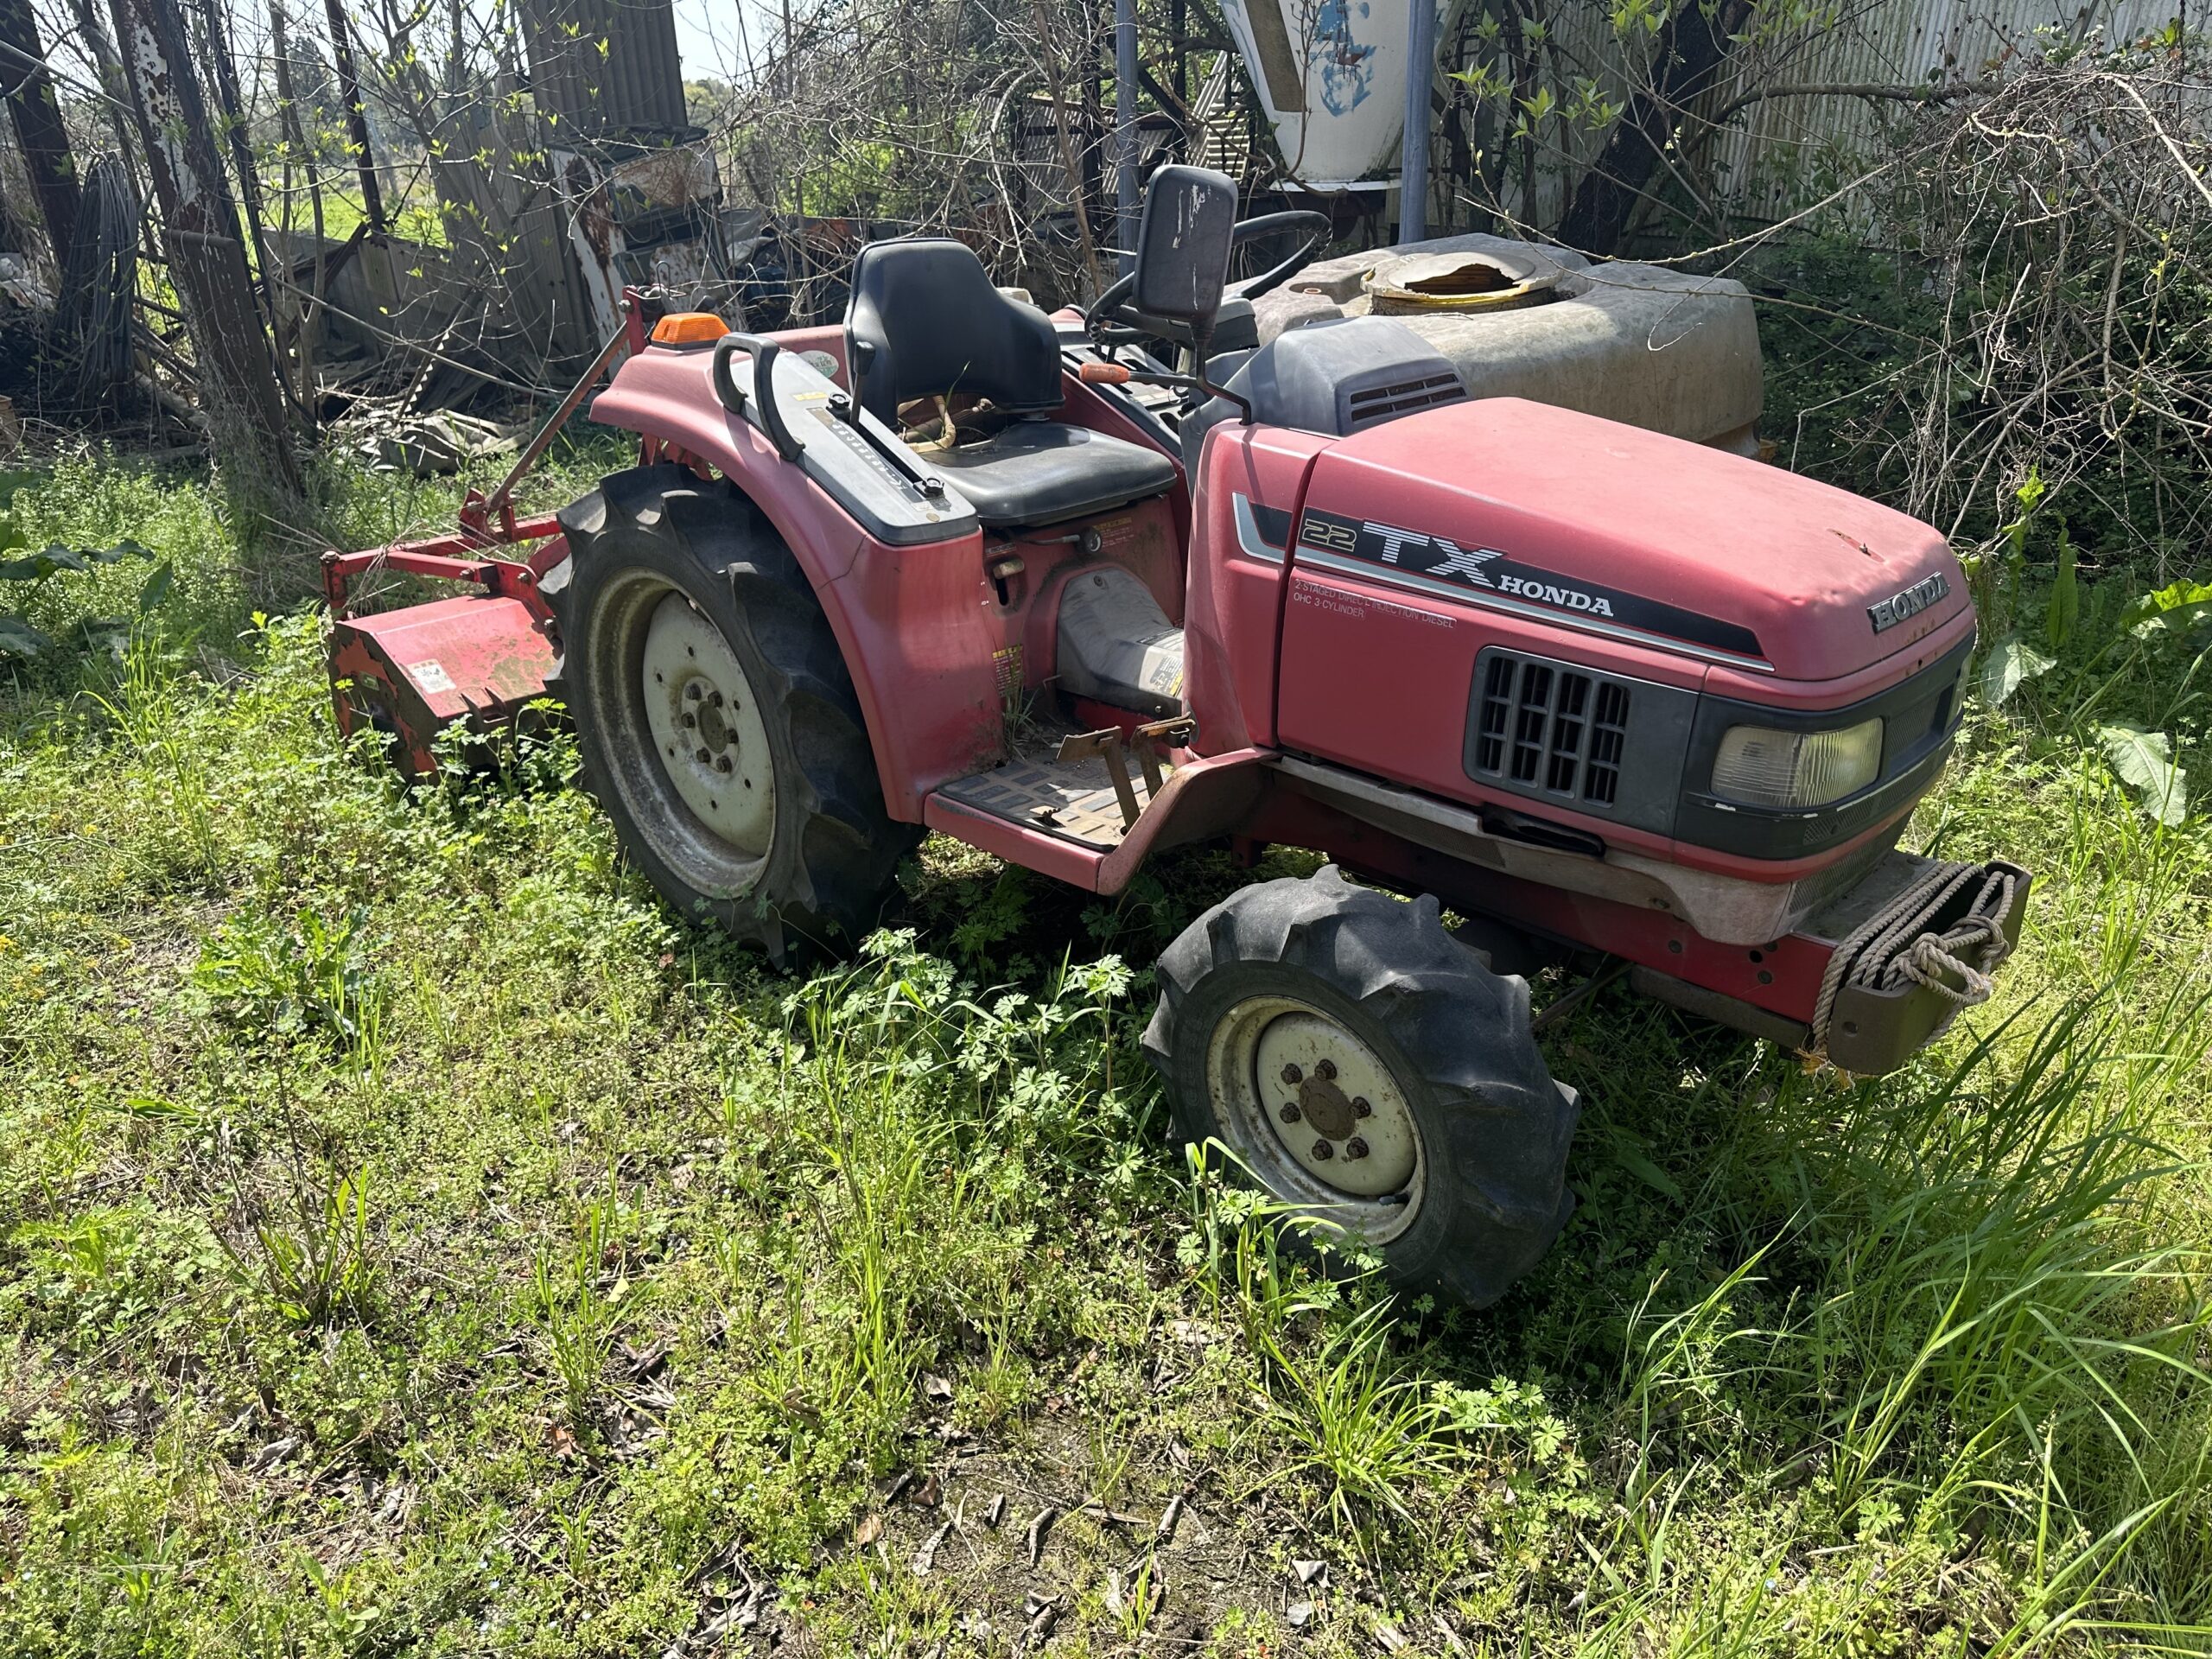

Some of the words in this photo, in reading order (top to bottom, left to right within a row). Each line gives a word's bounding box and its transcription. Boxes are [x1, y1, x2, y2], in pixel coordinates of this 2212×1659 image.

[1301, 518, 1357, 553] 22
[1363, 521, 1504, 589] TX
[1497, 575, 1614, 618] HONDA
[1293, 592, 1312, 604] OHC
[1871, 571, 1950, 632] HONDA
[1421, 613, 1454, 629] DIESEL
